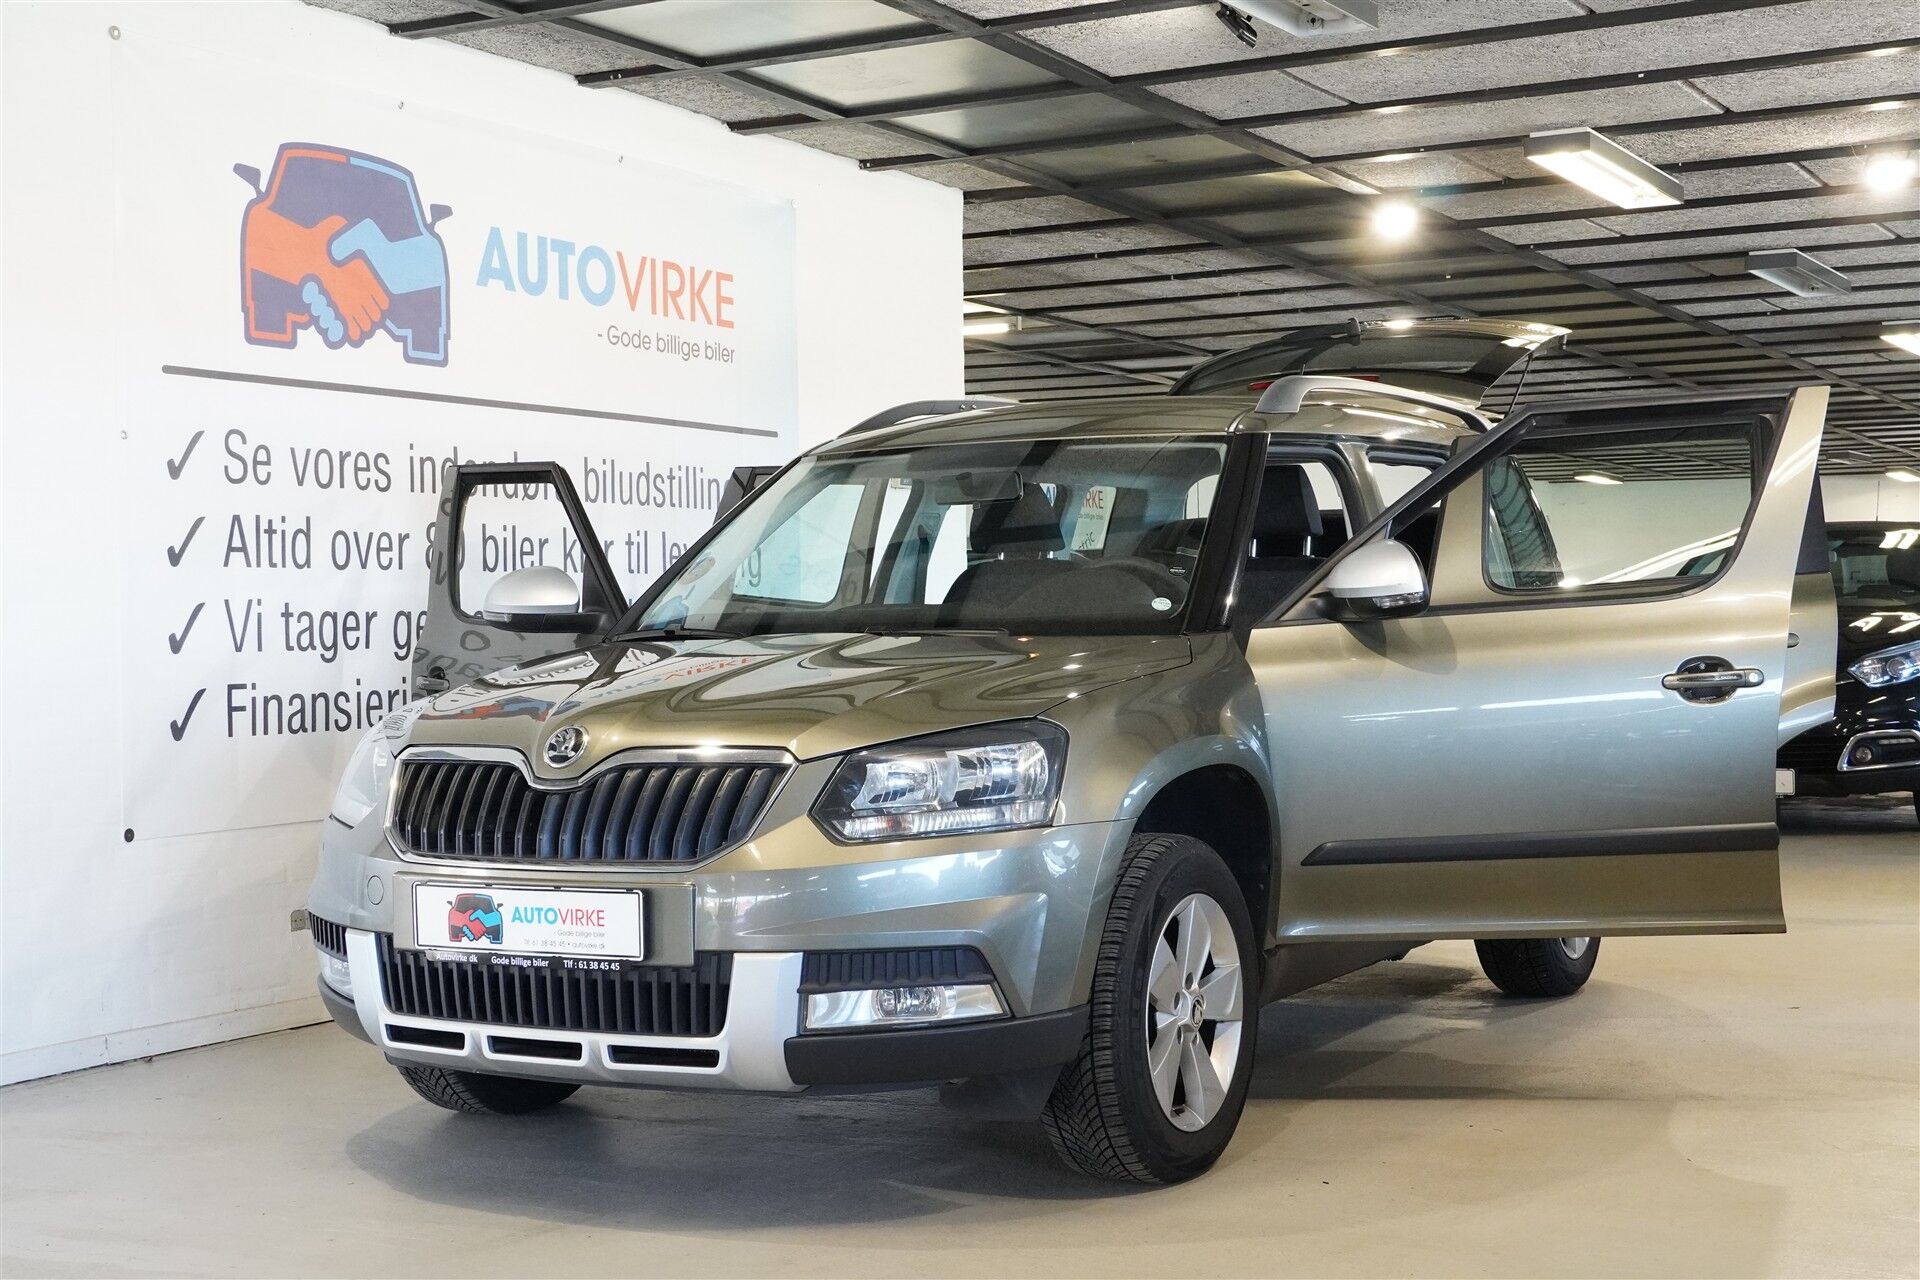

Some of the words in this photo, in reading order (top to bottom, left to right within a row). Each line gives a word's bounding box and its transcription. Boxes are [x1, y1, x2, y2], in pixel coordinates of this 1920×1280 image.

[476, 226, 734, 329] AUTOVIRKE
[607, 325, 651, 350] Gode
[656, 332, 701, 361] billige
[705, 341, 735, 363] biler
[224, 428, 271, 485] Se
[290, 447, 392, 493] vores
[584, 456, 728, 510] biludstillin
[223, 514, 312, 570] Altid
[331, 529, 410, 571] over
[482, 523, 549, 573] biler
[625, 530, 649, 574] til
[224, 598, 262, 652] Vi
[280, 602, 378, 663] tager
[227, 676, 407, 737] Finansieri
[511, 906, 605, 927] AUTOVIRKE
[491, 956, 510, 965] Gode
[511, 957, 531, 967] billige
[532, 958, 549, 967] biler
[579, 961, 588, 969] 61
[589, 961, 599, 970] 38
[600, 962, 609, 970] 45
[610, 962, 620, 970] 45
